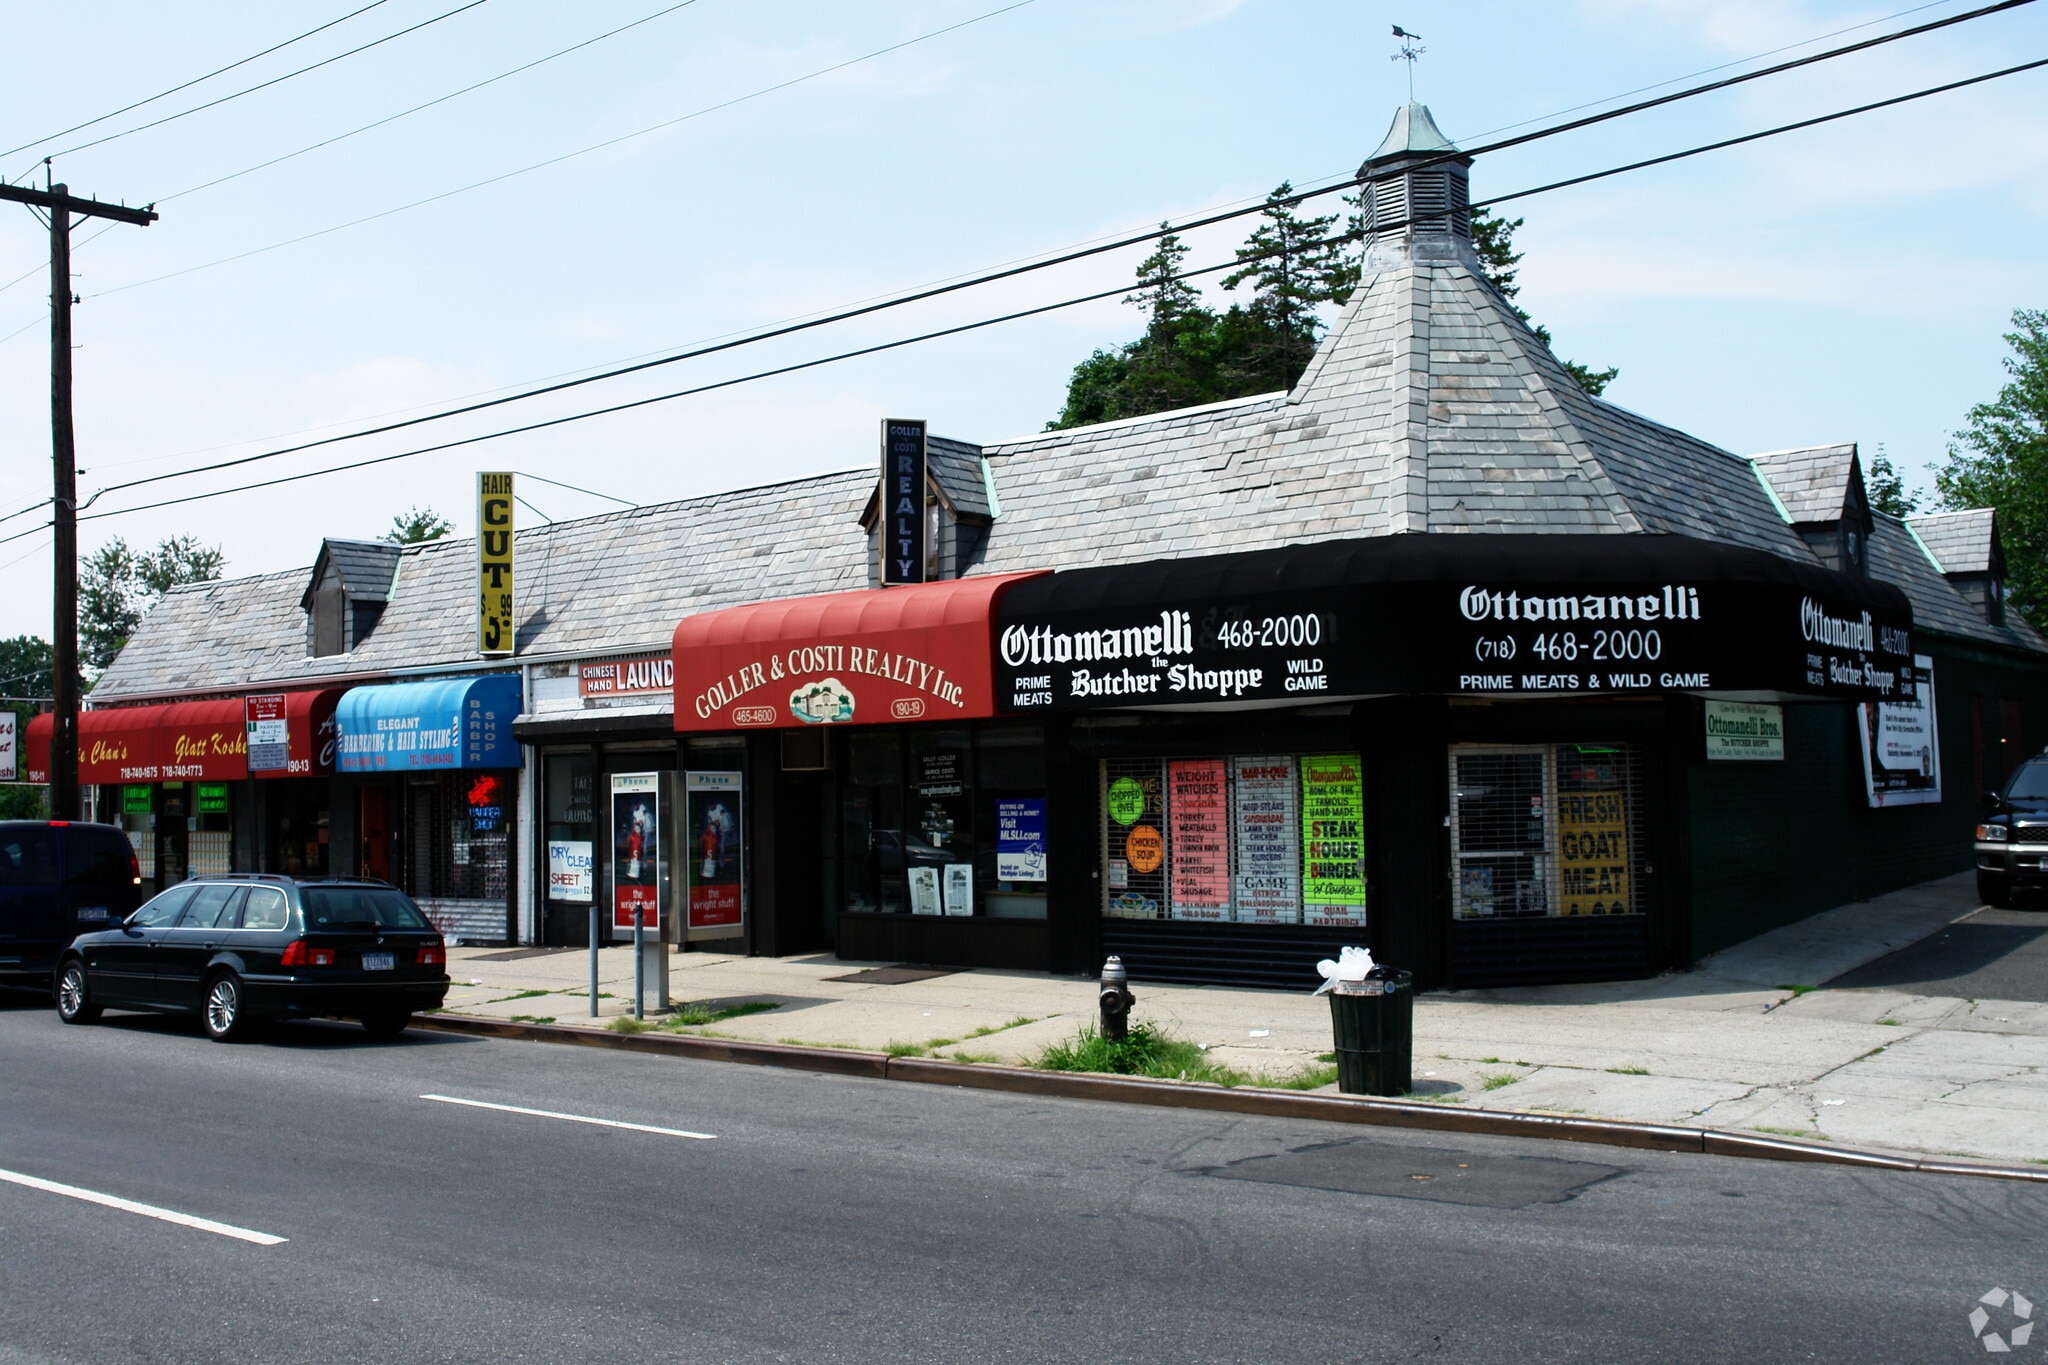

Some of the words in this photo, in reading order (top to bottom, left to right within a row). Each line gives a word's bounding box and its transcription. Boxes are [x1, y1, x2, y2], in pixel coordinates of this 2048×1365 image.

[891, 426, 921, 437] GOLLER
[894, 442, 917, 452] COSTI
[481, 474, 512, 495] HAIR
[896, 455, 915, 577] REALTY
[483, 499, 510, 588] CUT
[1460, 585, 1701, 621] Ottomanelli
[1801, 595, 1874, 653] Ottomanelli
[1000, 610, 1194, 667] Ottomanelli
[1217, 613, 1321, 649] 468-2000
[1475, 636, 1516, 662] (718)
[1533, 629, 1662, 661] 468-2000
[1151, 657, 1169, 668] the
[1287, 659, 1323, 674] WILD
[582, 665, 615, 679] CHINESE
[1830, 655, 1863, 687] Butcher
[1864, 661, 1895, 696] Shoppe
[587, 680, 612, 692] HAND
[695, 662, 767, 719] GOLLER
[770, 654, 785, 680] &
[788, 645, 844, 675] COSTI
[849, 646, 935, 691] REALTY
[933, 668, 964, 708] Inc.
[1015, 675, 1051, 690] PRIME
[1070, 667, 1161, 697] Butcher
[1168, 664, 1263, 695] Shoppe
[1284, 675, 1328, 691] GAME
[1460, 674, 1513, 689] PRIME
[1522, 674, 1579, 689] MEATS
[1588, 674, 1600, 688] &
[1609, 673, 1651, 688] WILD
[1660, 673, 1710, 687] GAME
[1013, 692, 1052, 707] MEATS
[736, 709, 773, 723] 465-4600
[895, 702, 921, 716] 190-19
[377, 717, 420, 731] ELEGANT
[469, 700, 481, 761] BARBER
[1708, 714, 1758, 735] Ottomanelli
[1760, 717, 1780, 736] Bros.
[484, 711, 495, 752] SHOP
[344, 733, 385, 753] BARBERING
[388, 732, 394, 751] &
[397, 731, 416, 751] HAIR
[420, 729, 451, 750] STYLING
[91, 740, 128, 765] Chan's
[175, 734, 207, 764] Glatt
[623, 777, 648, 786] Phone
[699, 775, 729, 784] Phone
[1176, 771, 1216, 781] WEIGHT
[1111, 791, 1140, 801] CHOPPED
[1176, 784, 1219, 794] WATCHERS
[1309, 786, 1327, 795] HOME
[1329, 786, 1338, 795] OF
[1341, 785, 1355, 795] THE
[1316, 797, 1349, 806] FAMOUS
[1559, 795, 1624, 824] FRESH
[1000, 818, 1017, 829] Visit
[1179, 823, 1217, 832] MEATBALLS
[1244, 825, 1262, 833] LAMB
[1312, 821, 1359, 838] STEAK
[1000, 829, 1040, 840] MLSLI.com
[1180, 835, 1204, 843] TURKEY
[1250, 833, 1278, 841] CHICKEN
[1131, 838, 1160, 847] CHICKEN
[1310, 841, 1359, 858] HOUSE
[1562, 831, 1623, 860] GOAT
[551, 846, 569, 859] DRY
[1136, 851, 1155, 860] SOUP
[1252, 854, 1282, 862] BURGERS
[1180, 866, 1215, 875] WHITEFISH
[1310, 862, 1360, 878] BURGER
[551, 873, 580, 885] SHEET
[1180, 878, 1197, 886] VEAL
[1244, 877, 1288, 889] GAME
[1564, 866, 1625, 895] MEAT
[633, 889, 643, 899] the
[708, 889, 719, 898] the
[1180, 887, 1213, 896] SAUSAGE
[693, 899, 717, 912] wright
[718, 898, 734, 909] stuff
[1324, 906, 1349, 916] QUAIL
